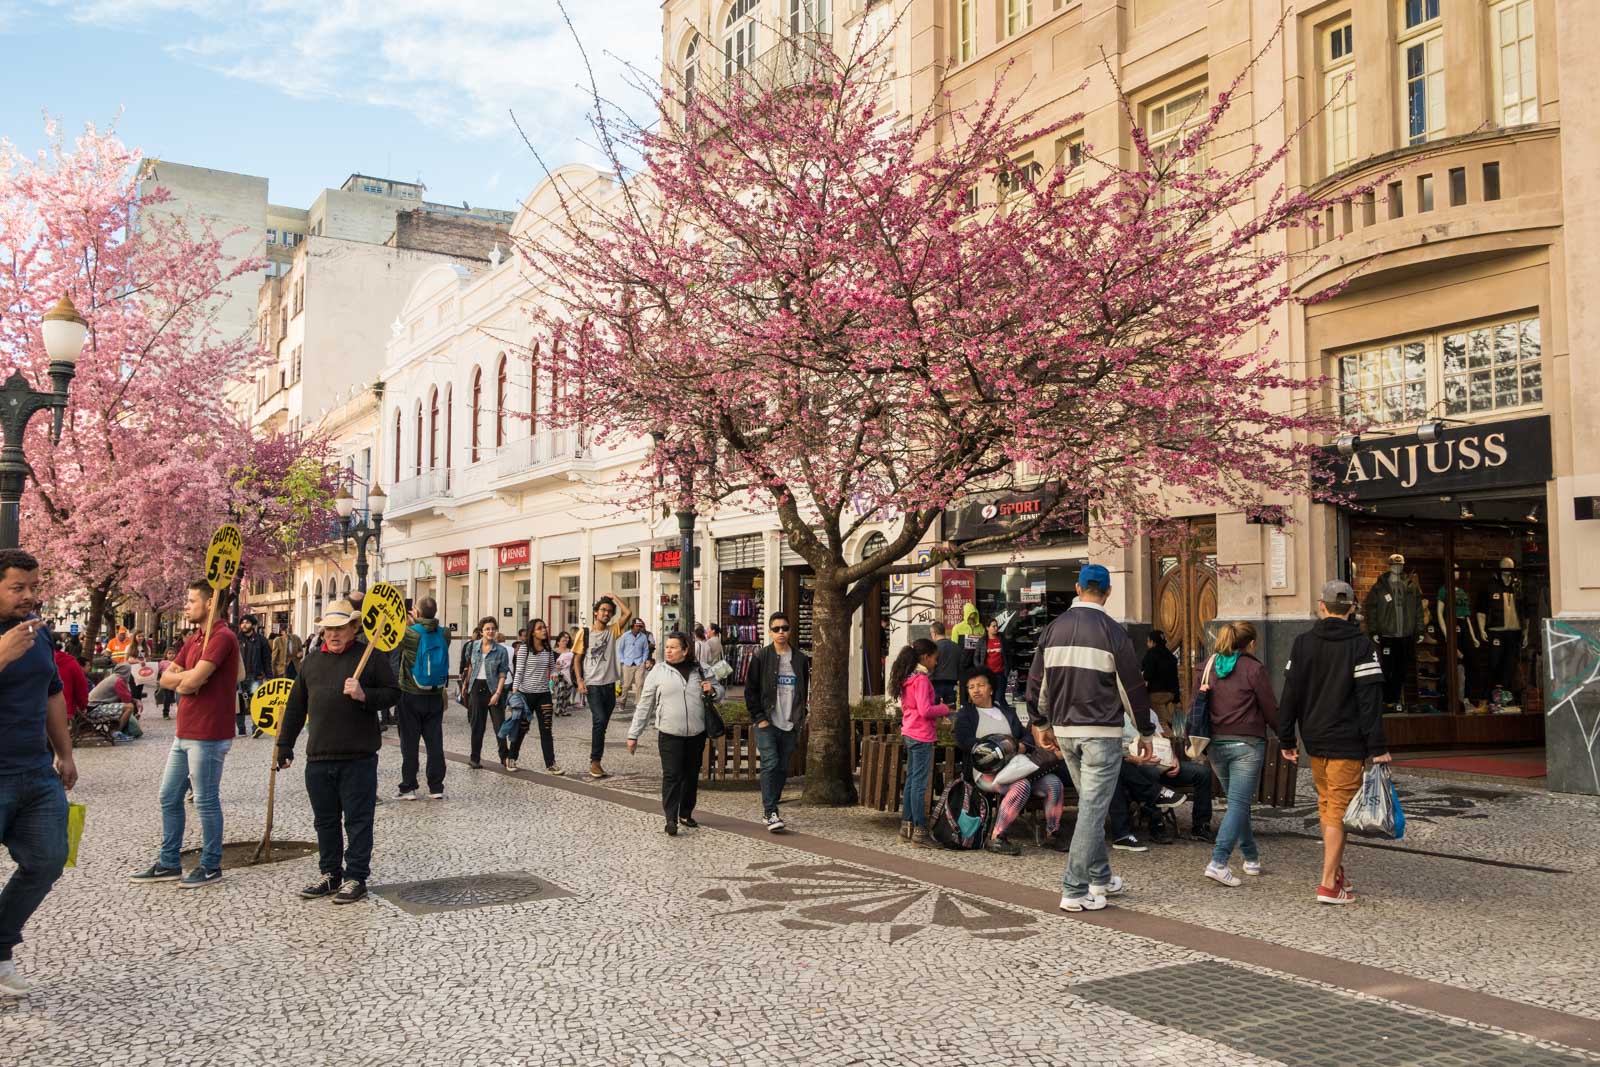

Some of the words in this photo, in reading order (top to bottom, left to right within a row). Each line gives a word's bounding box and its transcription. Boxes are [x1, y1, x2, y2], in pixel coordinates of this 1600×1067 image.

[1342, 433, 1508, 488] ANJUSS
[1000, 500, 1040, 516] SPORT
[212, 526, 241, 550] BUFFET
[452, 555, 467, 567] RENNER
[508, 547, 526, 560] RENNER
[207, 555, 236, 582] 5,95
[372, 584, 406, 624] BUFFET
[362, 604, 398, 645] 5,95
[257, 680, 292, 699] BUFF
[258, 706, 278, 730] 5,
